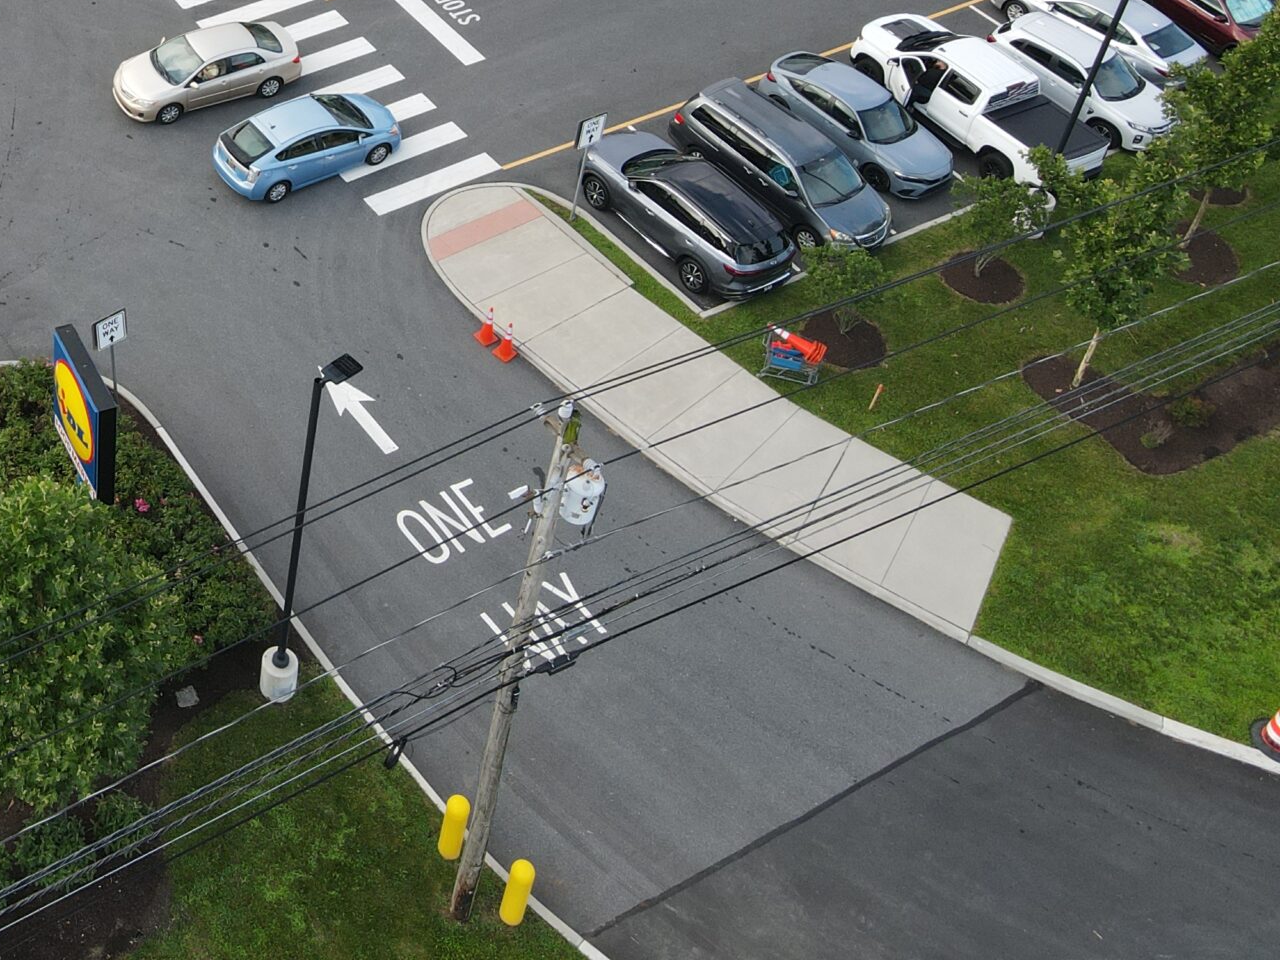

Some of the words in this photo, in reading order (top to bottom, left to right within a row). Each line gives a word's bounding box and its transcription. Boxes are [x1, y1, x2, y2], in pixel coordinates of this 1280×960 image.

[587, 120, 600, 129] ONE
[586, 126, 599, 135] WAY
[102, 317, 119, 330] ONE
[102, 325, 120, 338] WAY
